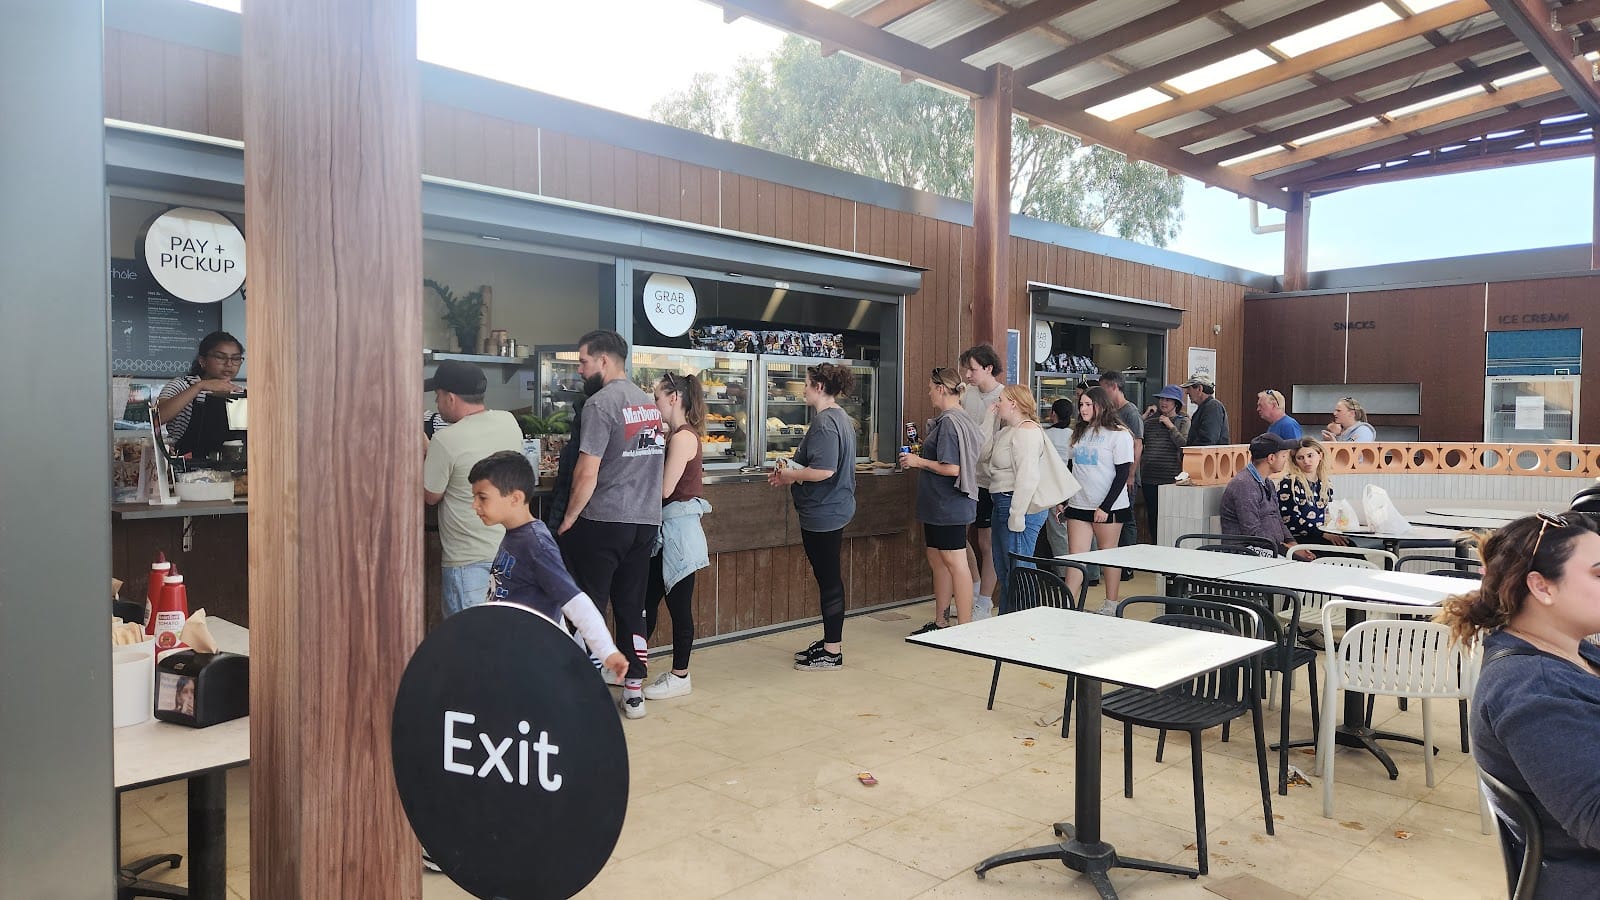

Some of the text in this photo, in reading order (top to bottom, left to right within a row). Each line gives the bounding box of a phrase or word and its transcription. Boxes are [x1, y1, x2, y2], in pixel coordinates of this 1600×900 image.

[170, 236, 224, 254] PAY +
[161, 252, 235, 273] PICKUP
[654, 290, 685, 303] GRAB
[655, 302, 685, 315] & GO
[1498, 312, 1570, 325] ICE CREAM
[1333, 320, 1376, 331] SNACKS
[443, 710, 563, 792] Exit
